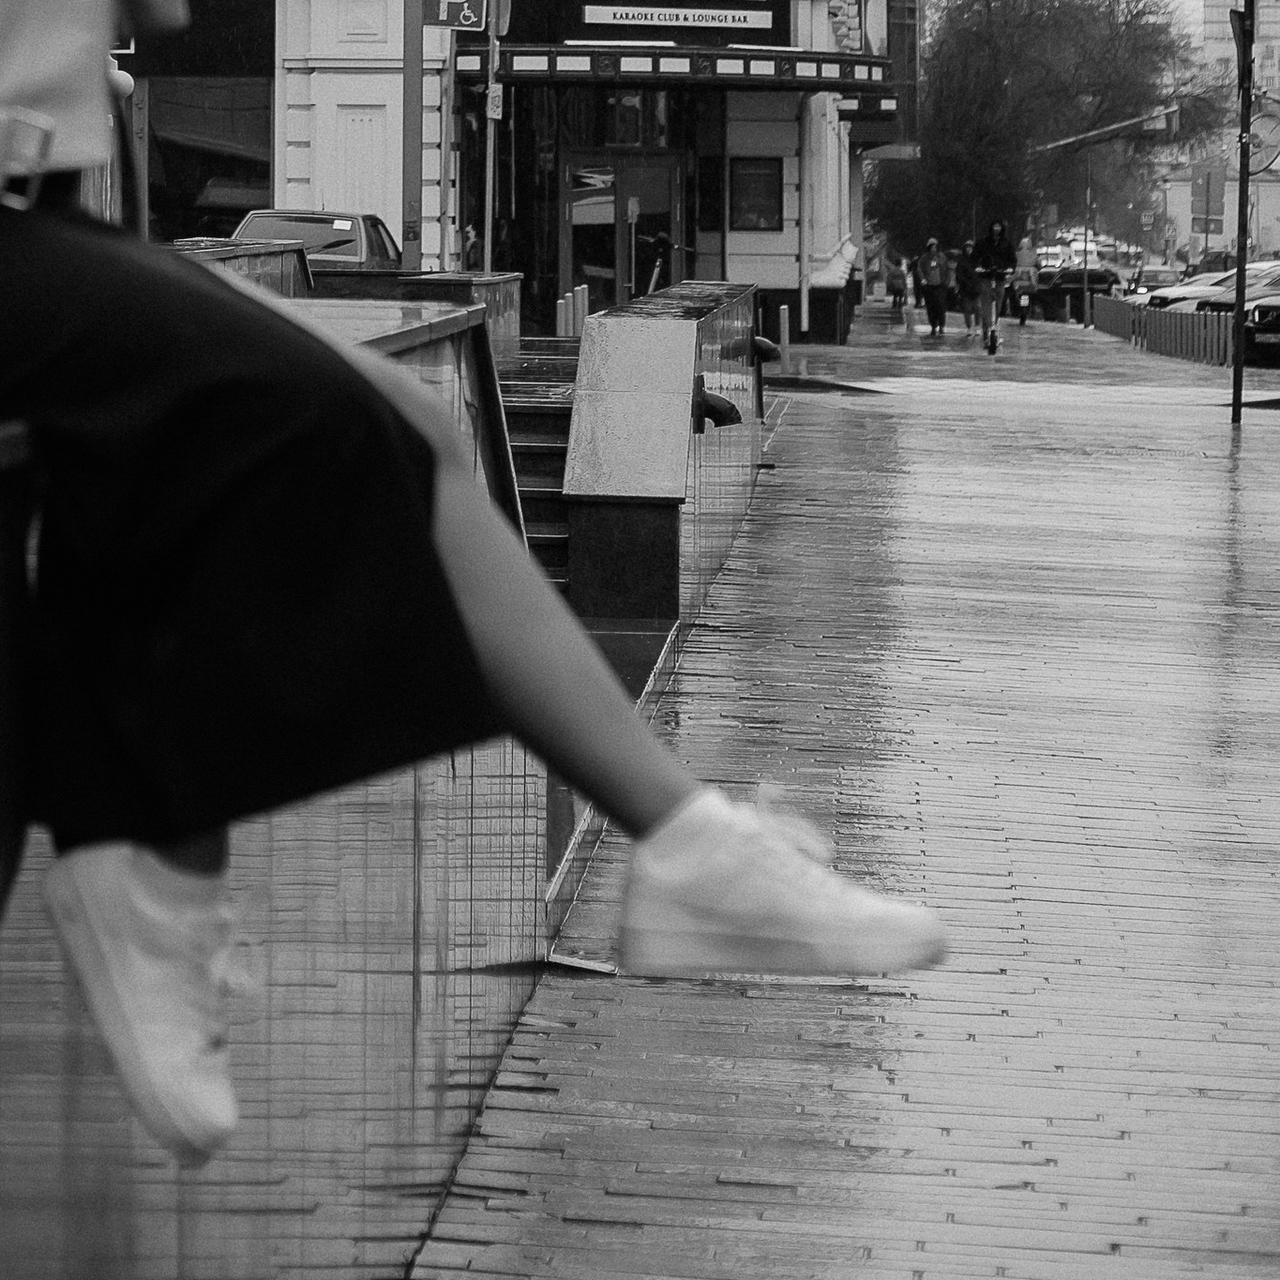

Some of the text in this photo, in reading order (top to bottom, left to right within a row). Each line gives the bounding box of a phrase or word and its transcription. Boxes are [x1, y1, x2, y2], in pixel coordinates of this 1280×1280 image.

[612, 11, 749, 24] KARAOKE CLUB & LOUNGE BAR
